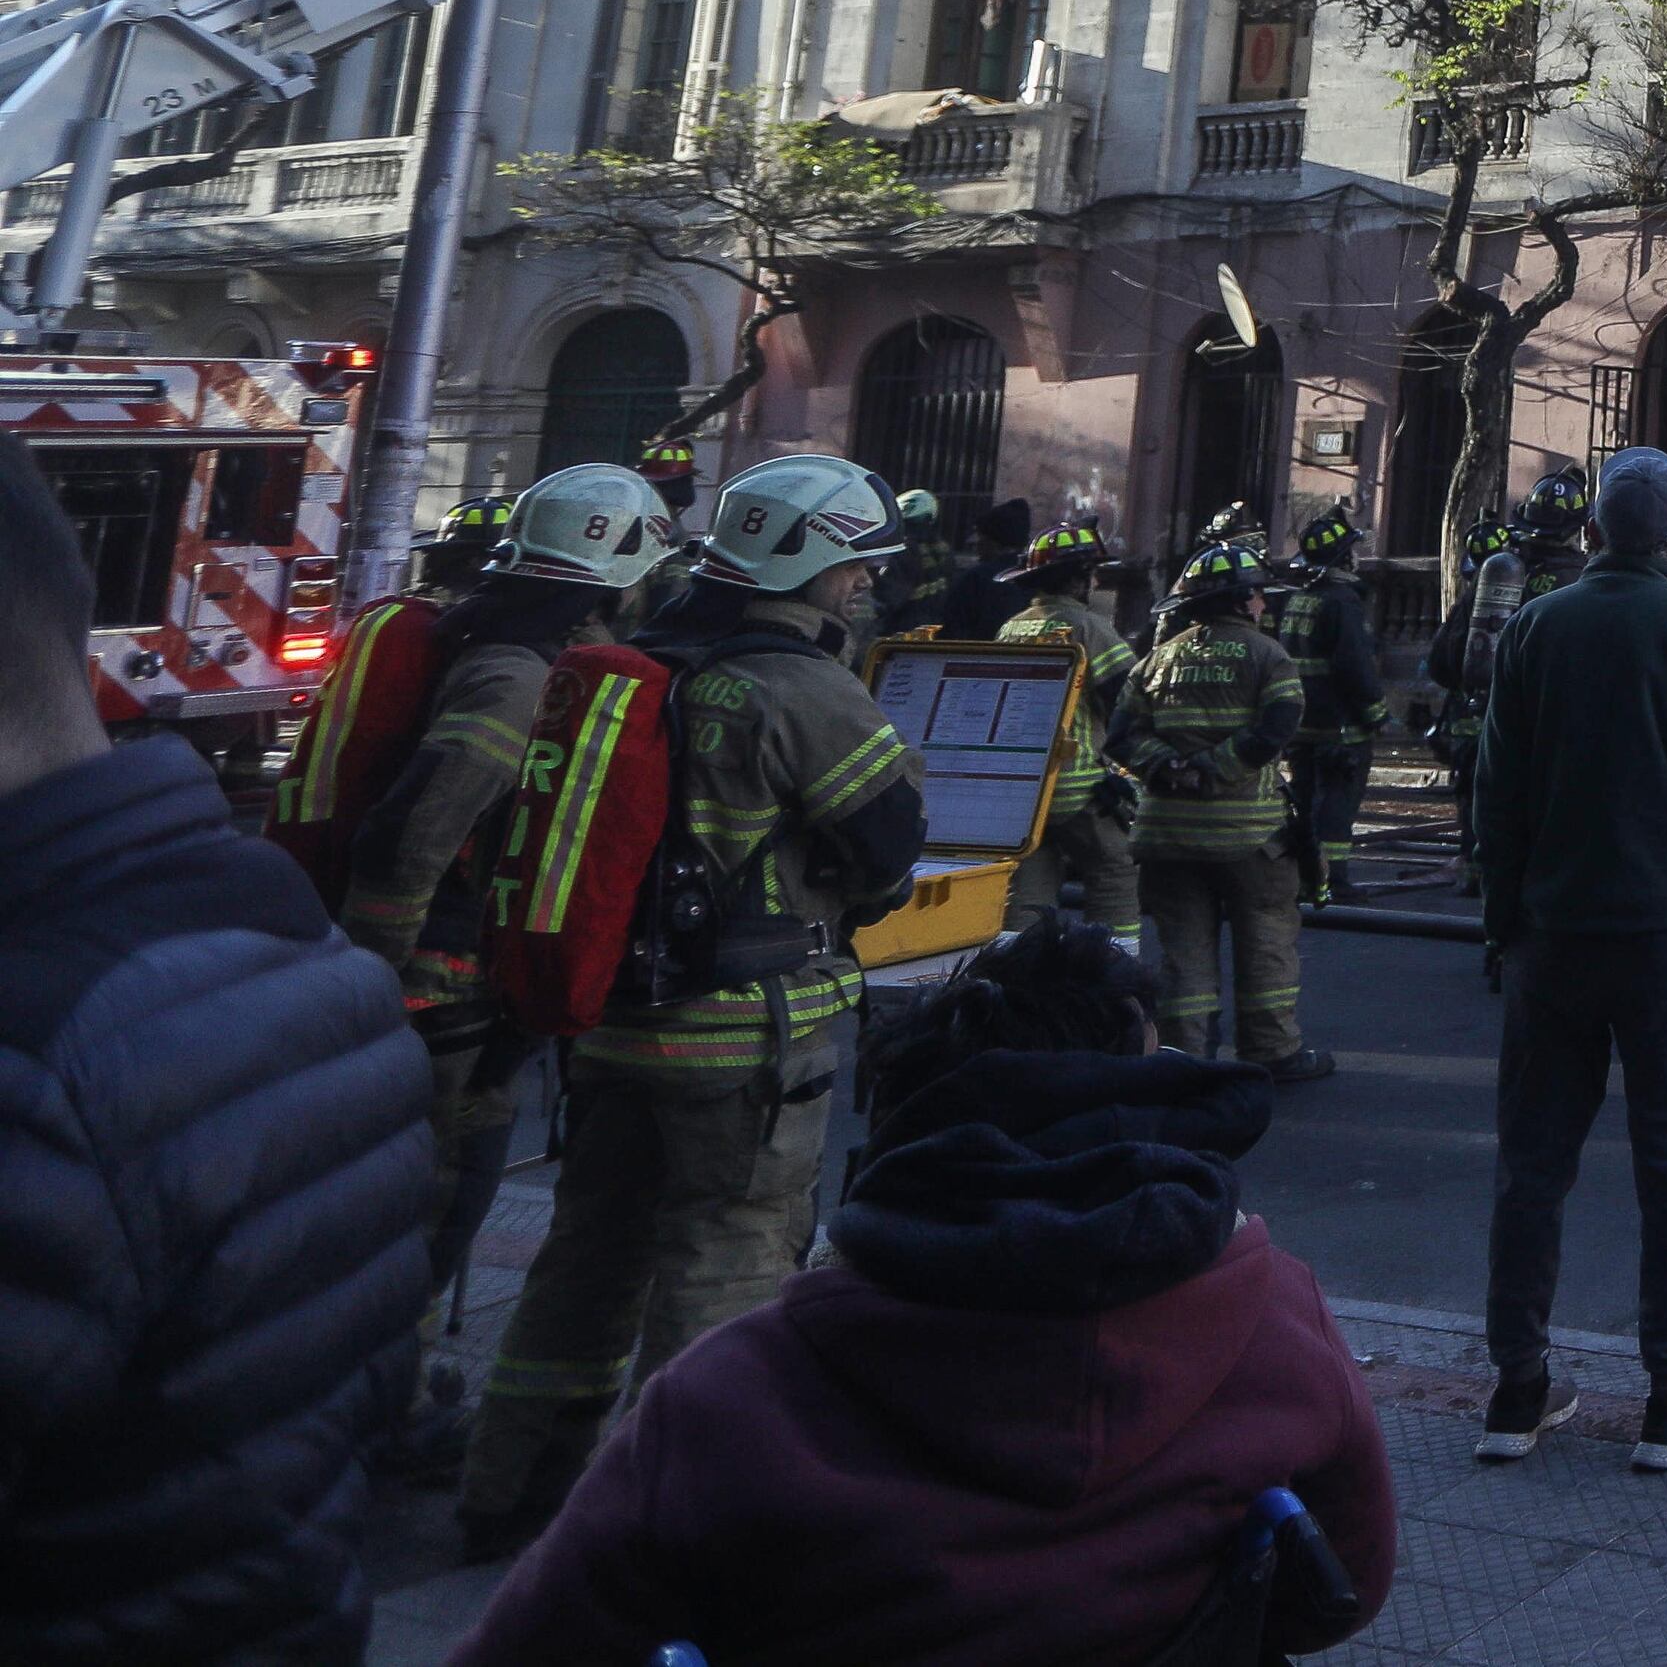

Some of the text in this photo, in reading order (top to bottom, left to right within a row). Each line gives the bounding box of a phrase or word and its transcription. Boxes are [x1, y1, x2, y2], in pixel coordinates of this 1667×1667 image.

[143, 77, 218, 117] 23 M
[1553, 483, 1565, 496] 9
[584, 514, 610, 541] 8
[742, 506, 768, 535] 8
